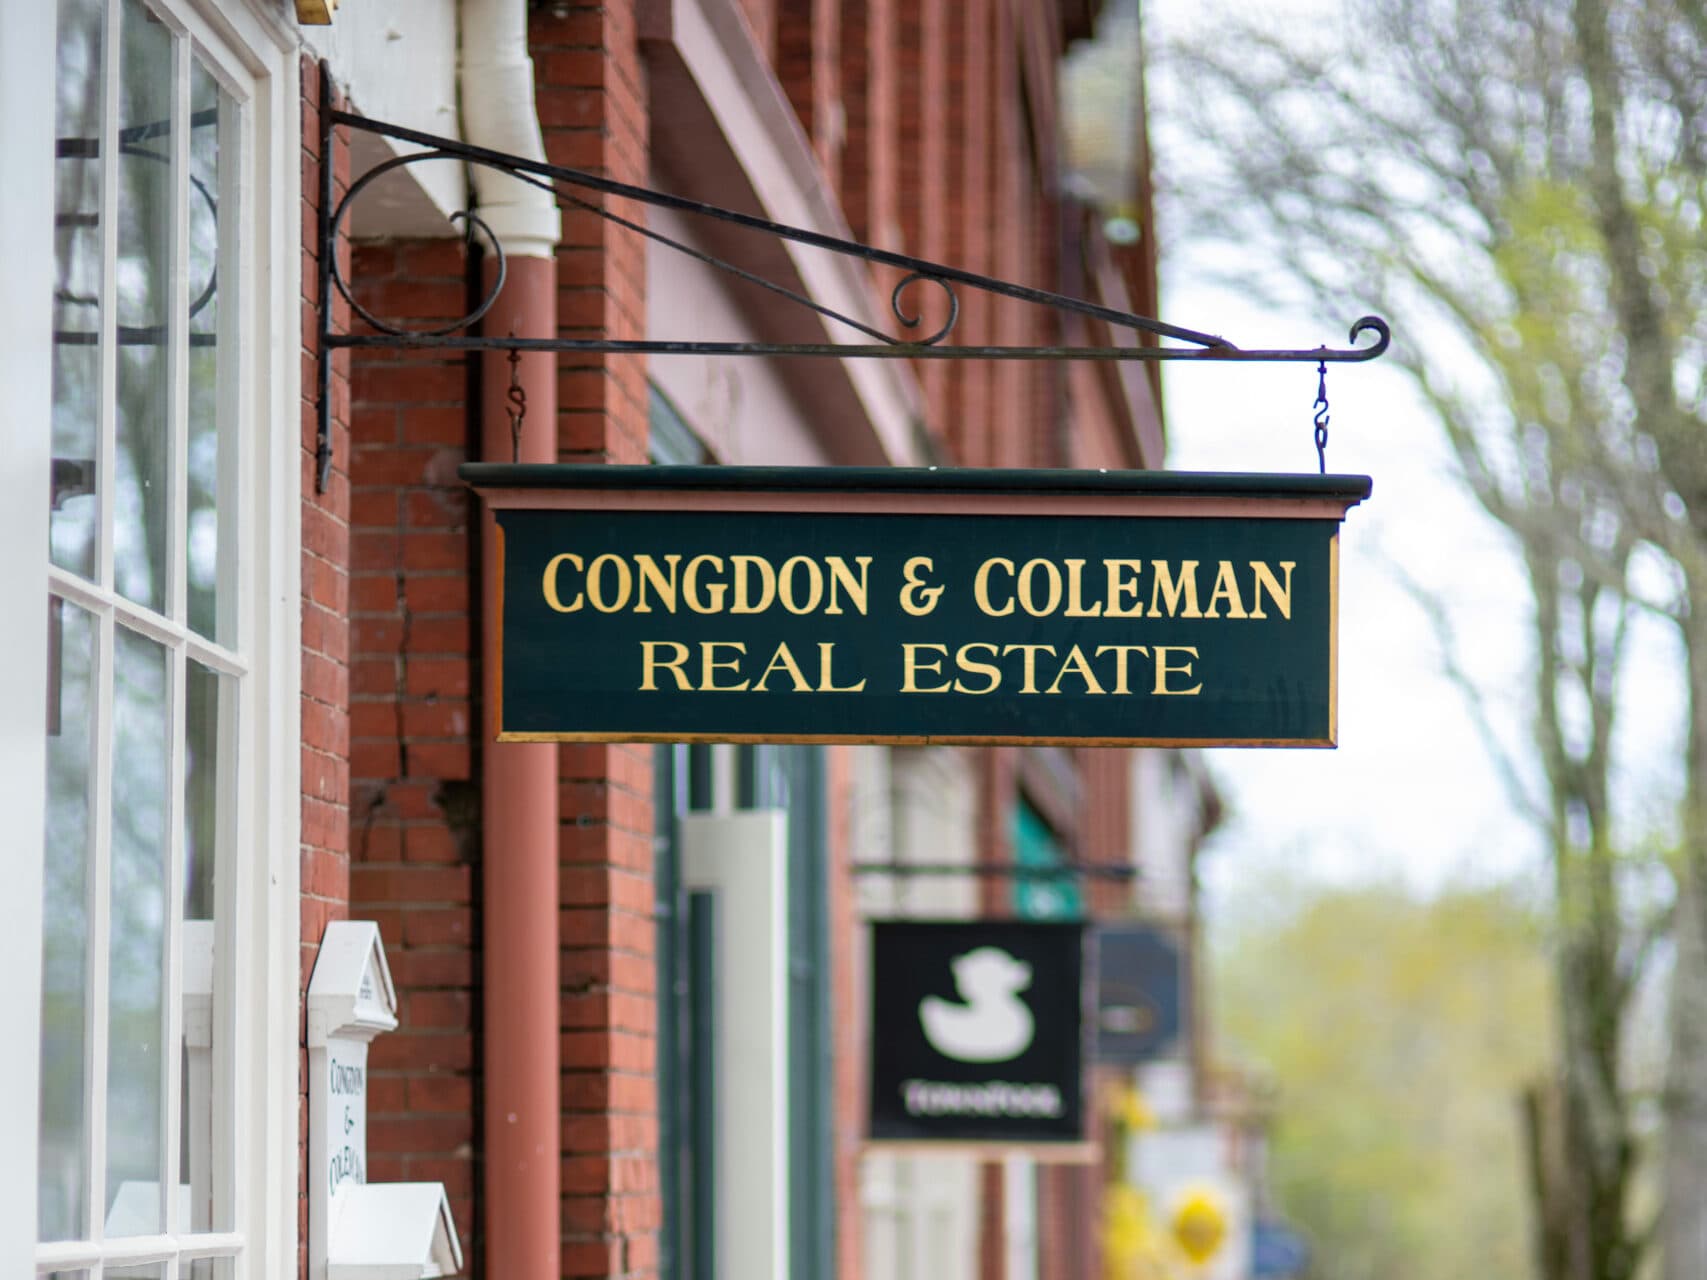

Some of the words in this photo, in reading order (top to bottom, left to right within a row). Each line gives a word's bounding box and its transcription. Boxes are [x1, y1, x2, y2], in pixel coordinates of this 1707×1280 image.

[542, 553, 873, 616] CONGDON
[899, 556, 945, 616] &
[974, 557, 1297, 620] COLEMAN
[639, 641, 866, 692] REAL
[899, 643, 1203, 695] ESTATE
